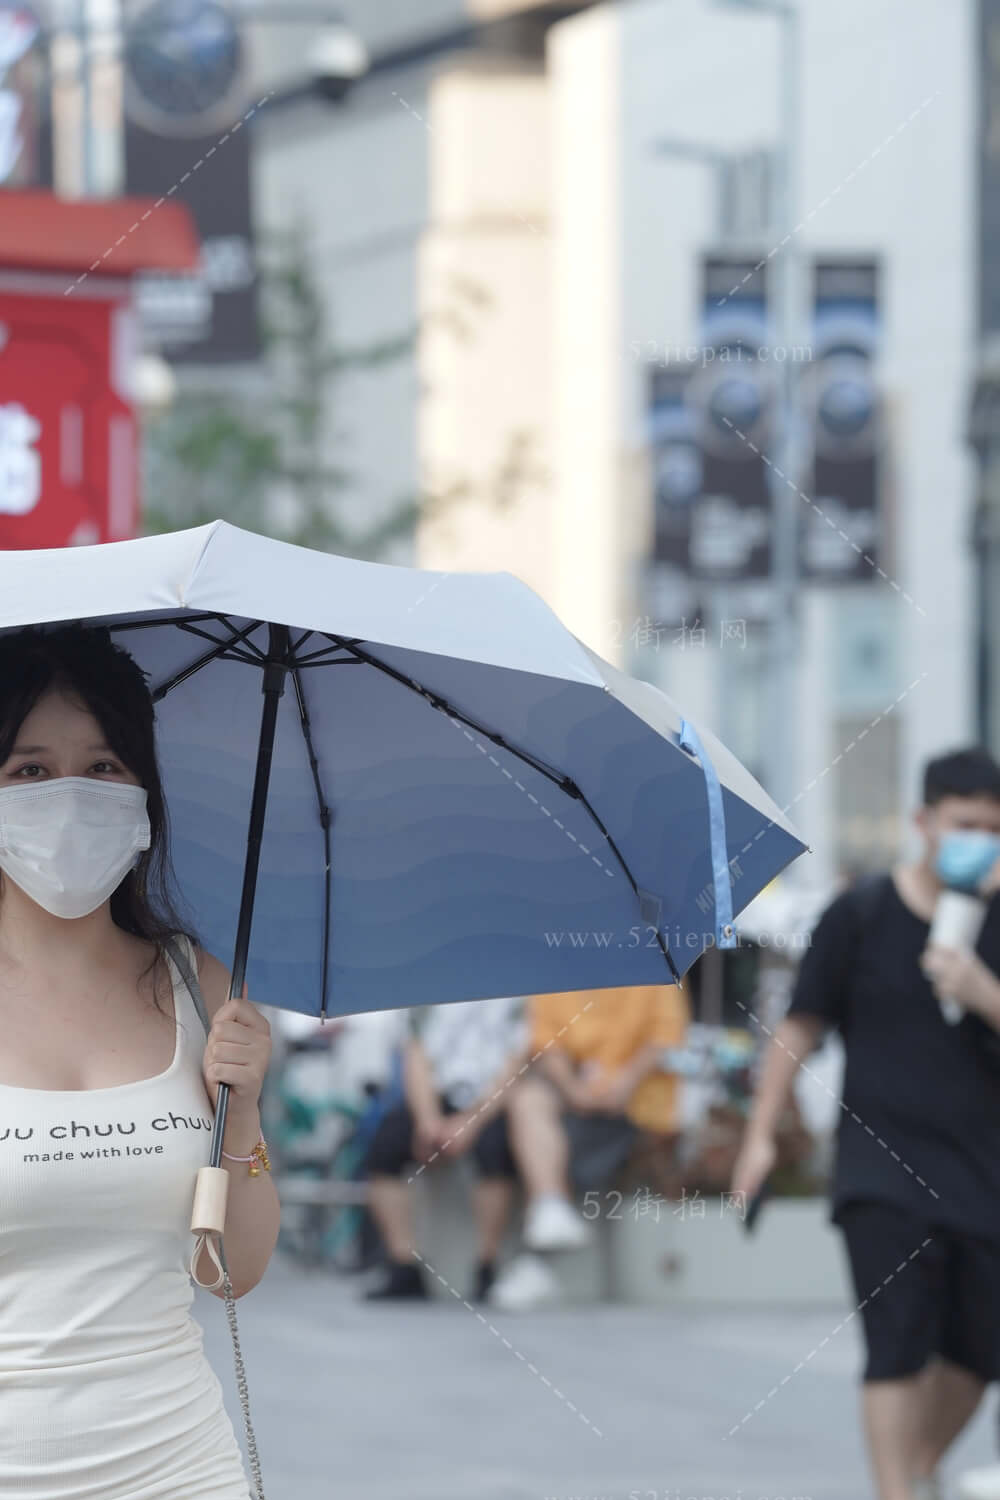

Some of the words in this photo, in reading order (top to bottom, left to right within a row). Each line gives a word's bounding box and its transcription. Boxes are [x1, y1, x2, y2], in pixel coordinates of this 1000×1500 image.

[49, 1120, 136, 1140] chuu
[151, 1111, 212, 1132] chuu
[23, 1150, 75, 1163] made
[80, 1147, 121, 1160] with
[126, 1143, 164, 1156] love
